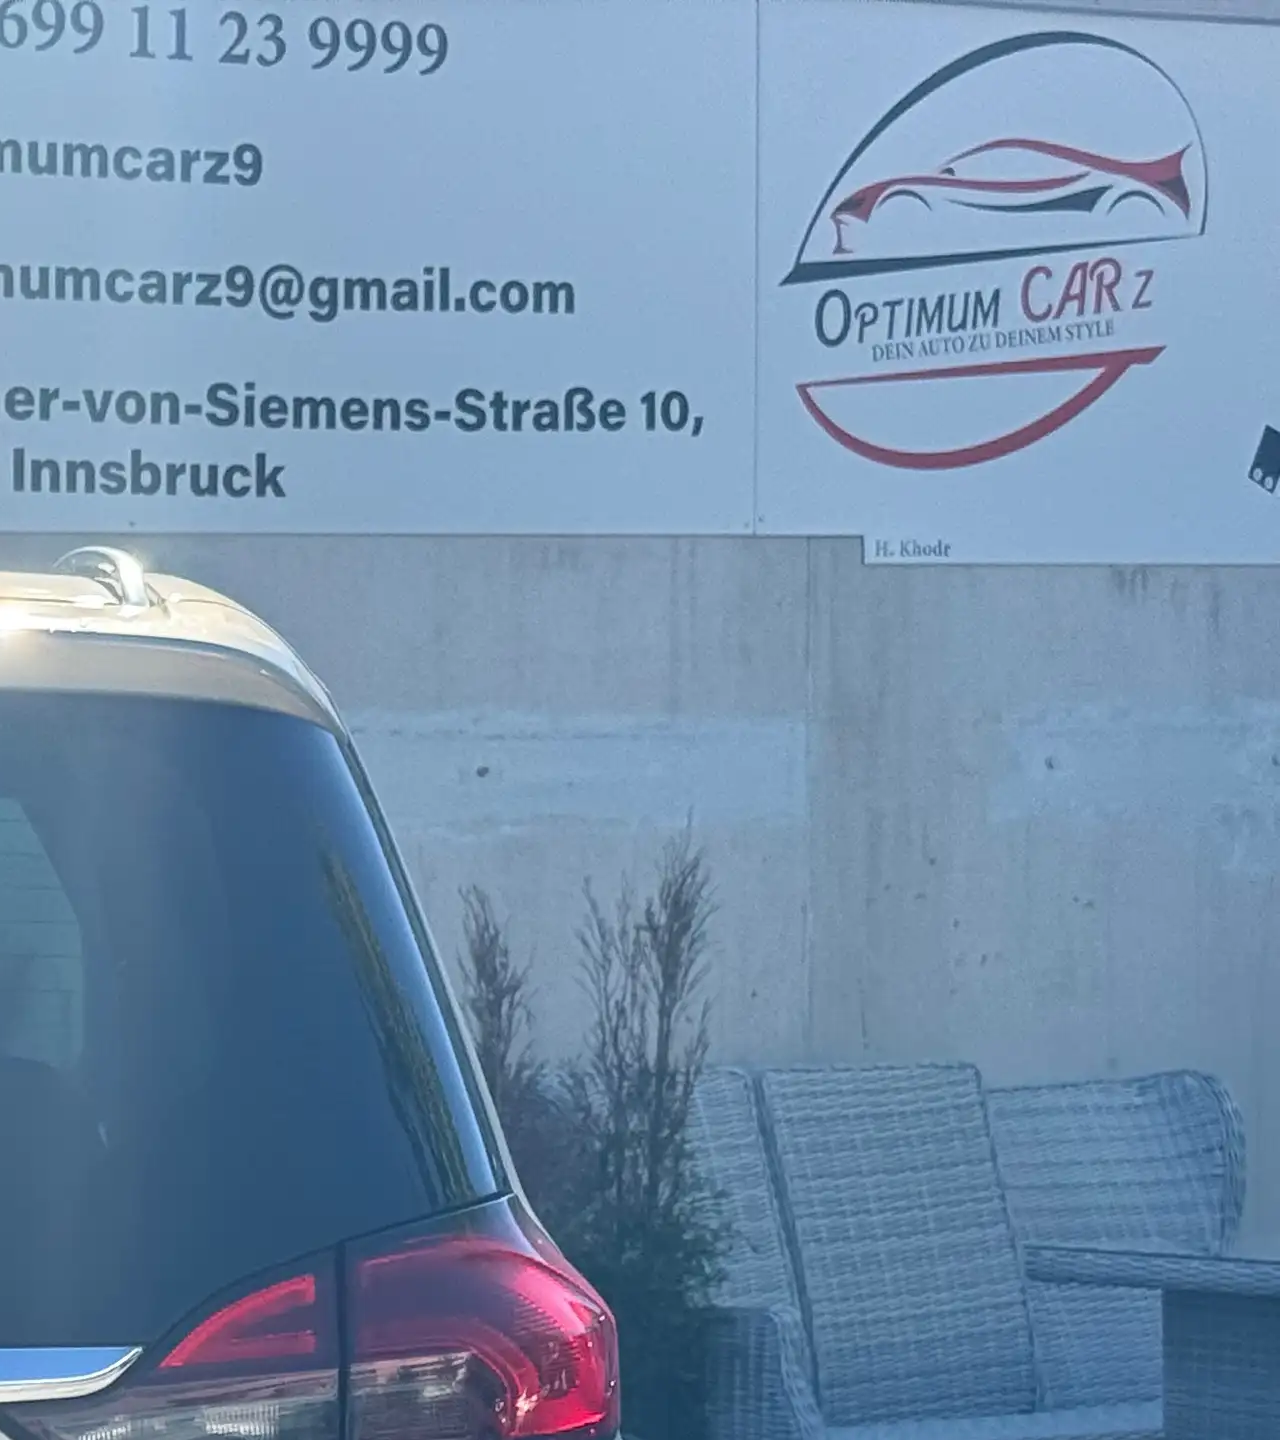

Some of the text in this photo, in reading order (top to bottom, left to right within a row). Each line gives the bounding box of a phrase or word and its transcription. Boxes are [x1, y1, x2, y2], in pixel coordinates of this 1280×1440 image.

[128, 6, 194, 62] 11
[218, 11, 287, 68] 23
[308, 16, 450, 76] 9999
[1020, 257, 1123, 323] CAR
[871, 319, 1116, 362] DEIN AUTO ZU DEINEM STYLE
[640, 391, 705, 438] 10,
[13, 449, 287, 499] Innsbruck
